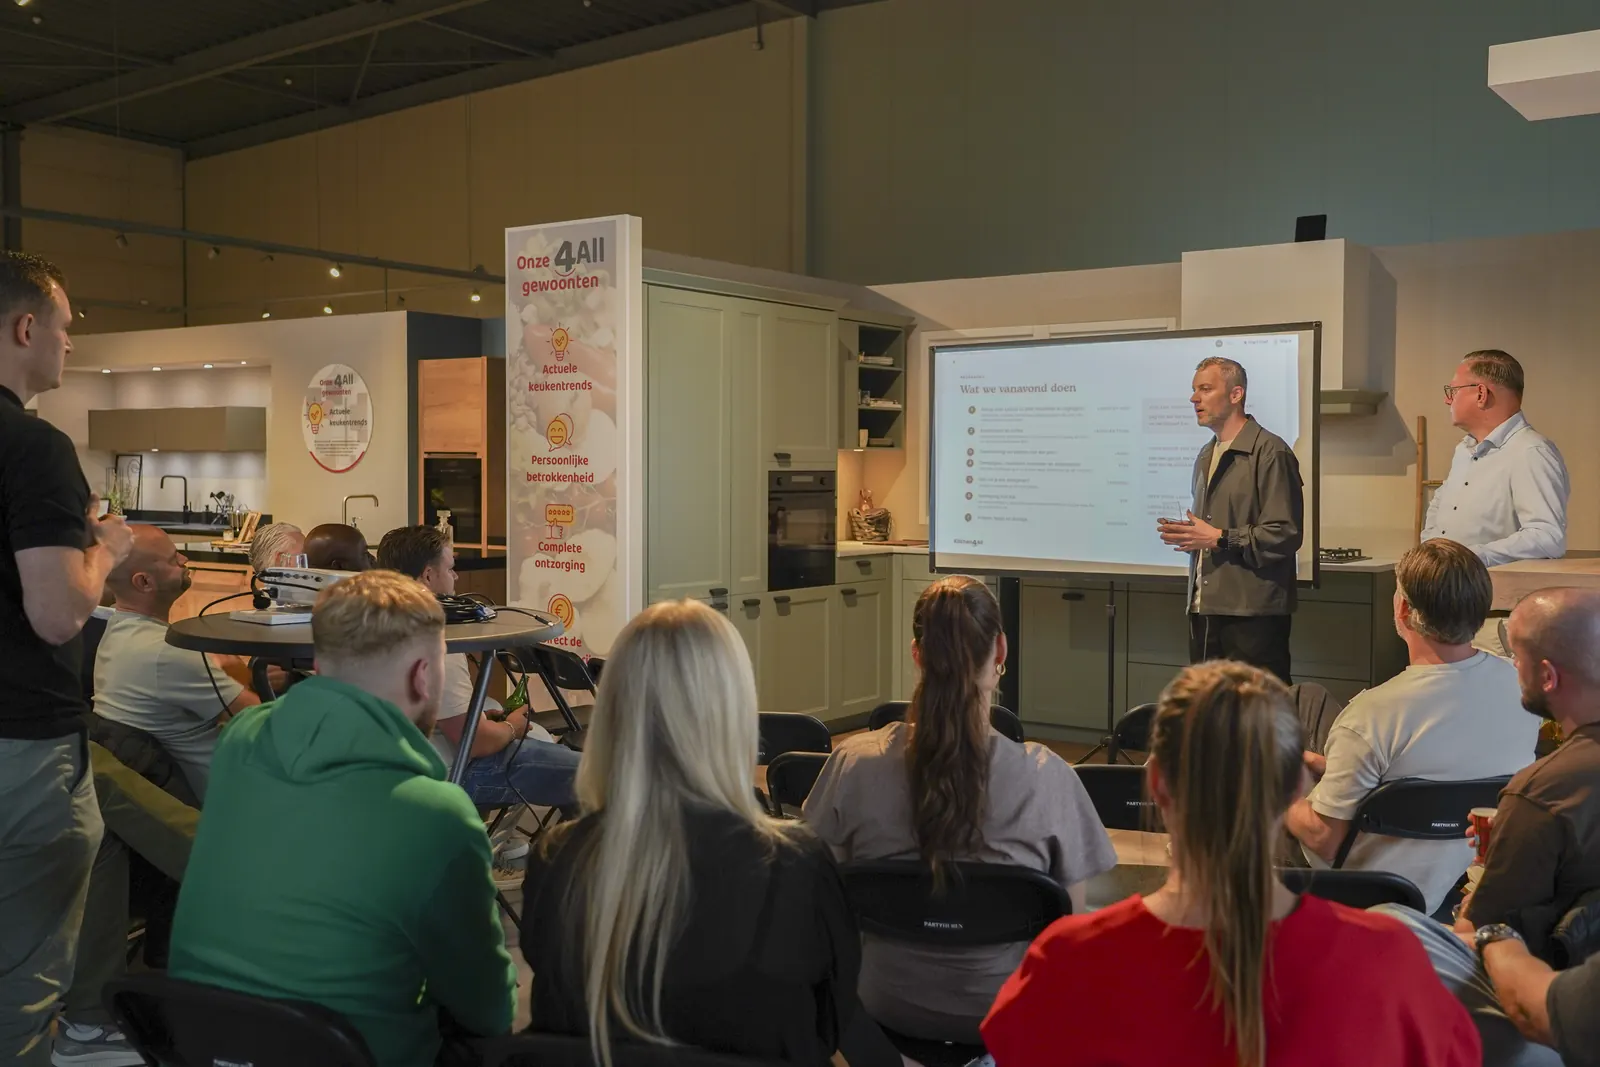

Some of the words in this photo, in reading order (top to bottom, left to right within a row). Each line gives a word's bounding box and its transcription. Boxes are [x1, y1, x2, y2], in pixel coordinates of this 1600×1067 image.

[517, 254, 550, 270] Onze
[554, 237, 605, 272] 4All
[522, 275, 599, 296] gewoonten
[542, 363, 578, 374] Actuele
[334, 373, 354, 387] 4All
[528, 379, 593, 392] keukentrends
[960, 384, 979, 394] Wat
[999, 383, 1048, 394] vanavond
[1051, 383, 1077, 393] doen
[329, 407, 351, 415] Actuele
[329, 418, 368, 427] keukentrends
[531, 455, 589, 468] Persoonlijke
[526, 472, 594, 483] betrokkenheid
[538, 541, 582, 554] Complete
[535, 559, 586, 573] ontzorging
[570, 636, 582, 647] de
